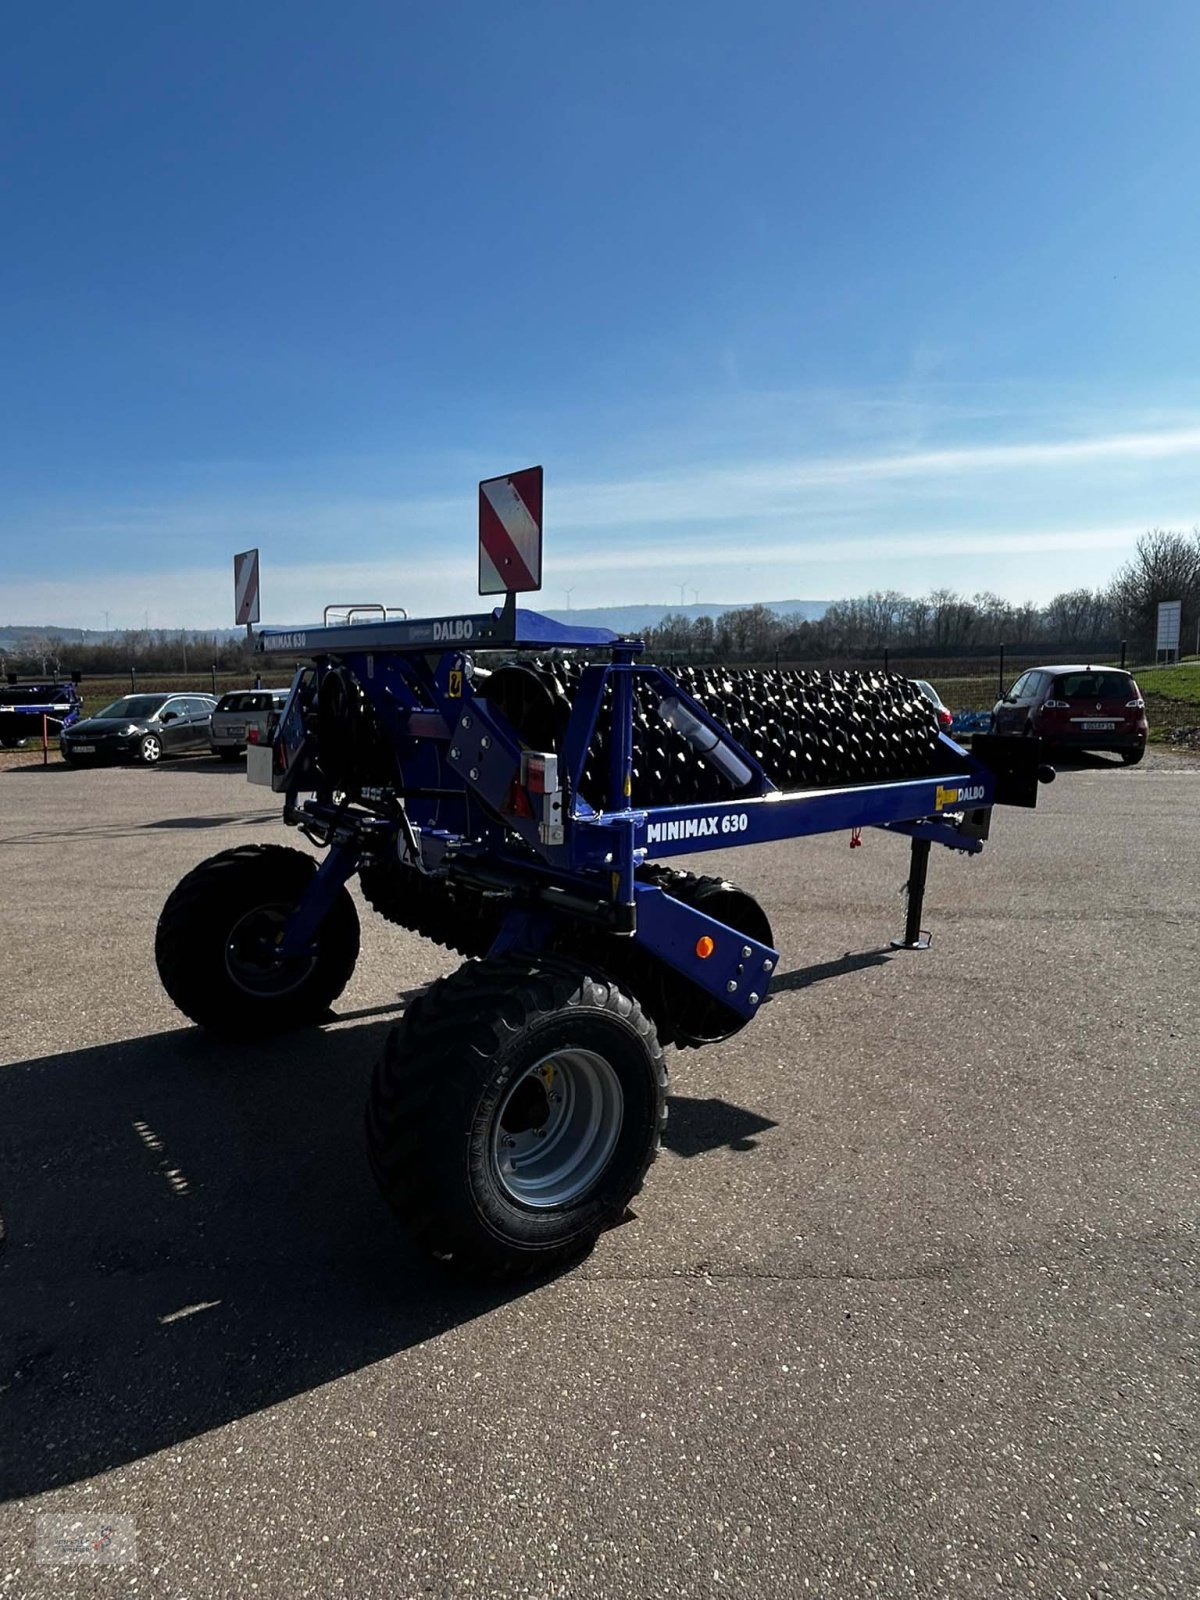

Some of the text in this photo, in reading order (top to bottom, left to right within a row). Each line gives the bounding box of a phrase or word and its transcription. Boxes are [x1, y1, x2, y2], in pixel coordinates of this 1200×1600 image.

[433, 620, 473, 640] DALBO
[264, 631, 306, 650] MINIMAX 630
[958, 786, 985, 802] DALBO
[647, 813, 748, 842] MINIMAX 630
